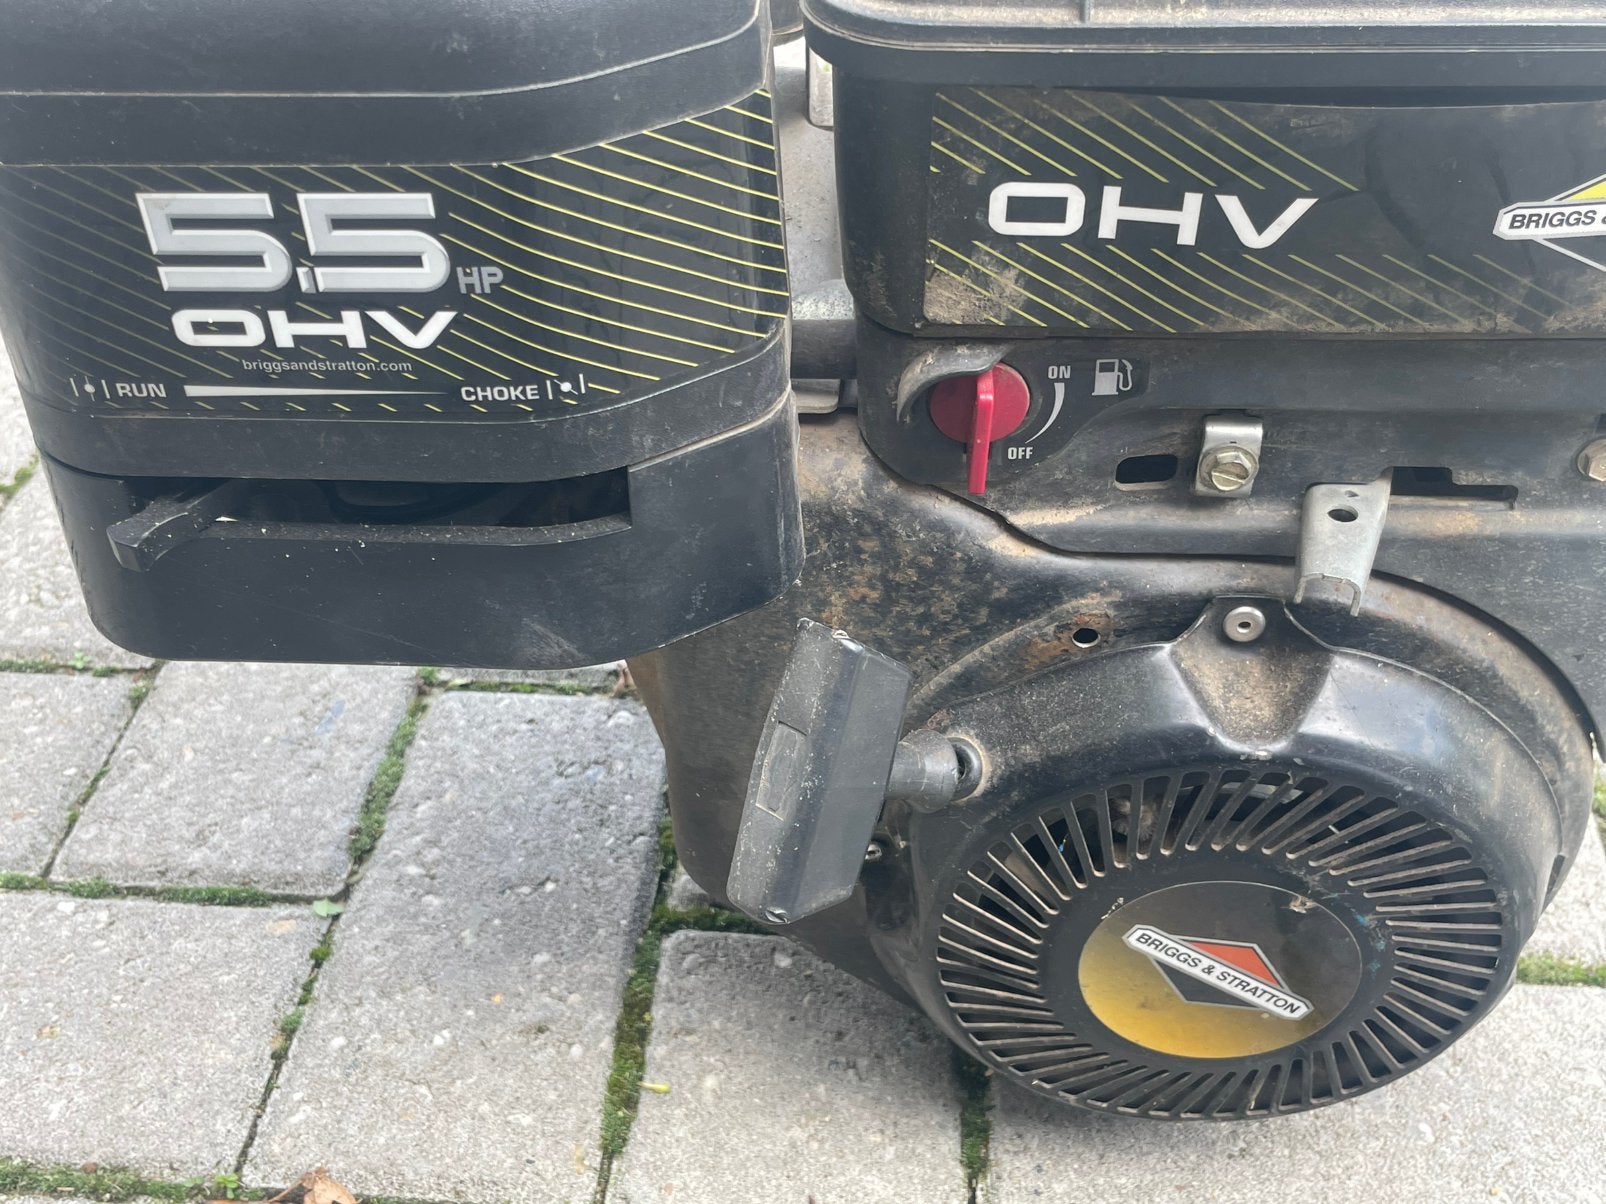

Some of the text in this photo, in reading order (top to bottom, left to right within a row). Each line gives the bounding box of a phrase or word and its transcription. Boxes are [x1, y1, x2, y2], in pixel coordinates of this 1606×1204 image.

[987, 181, 1319, 249] OHV
[1508, 209, 1597, 230] BRIGGS
[135, 192, 504, 294] 5.5 HP
[171, 308, 458, 349] OHV
[242, 358, 413, 375] briggsandstratton.com
[1047, 365, 1071, 379] ON
[115, 383, 167, 398] RUN
[460, 385, 540, 401] CHOKE
[1007, 447, 1033, 460] OFF
[1136, 933, 1300, 1014] BRIGGS & STRATTON
